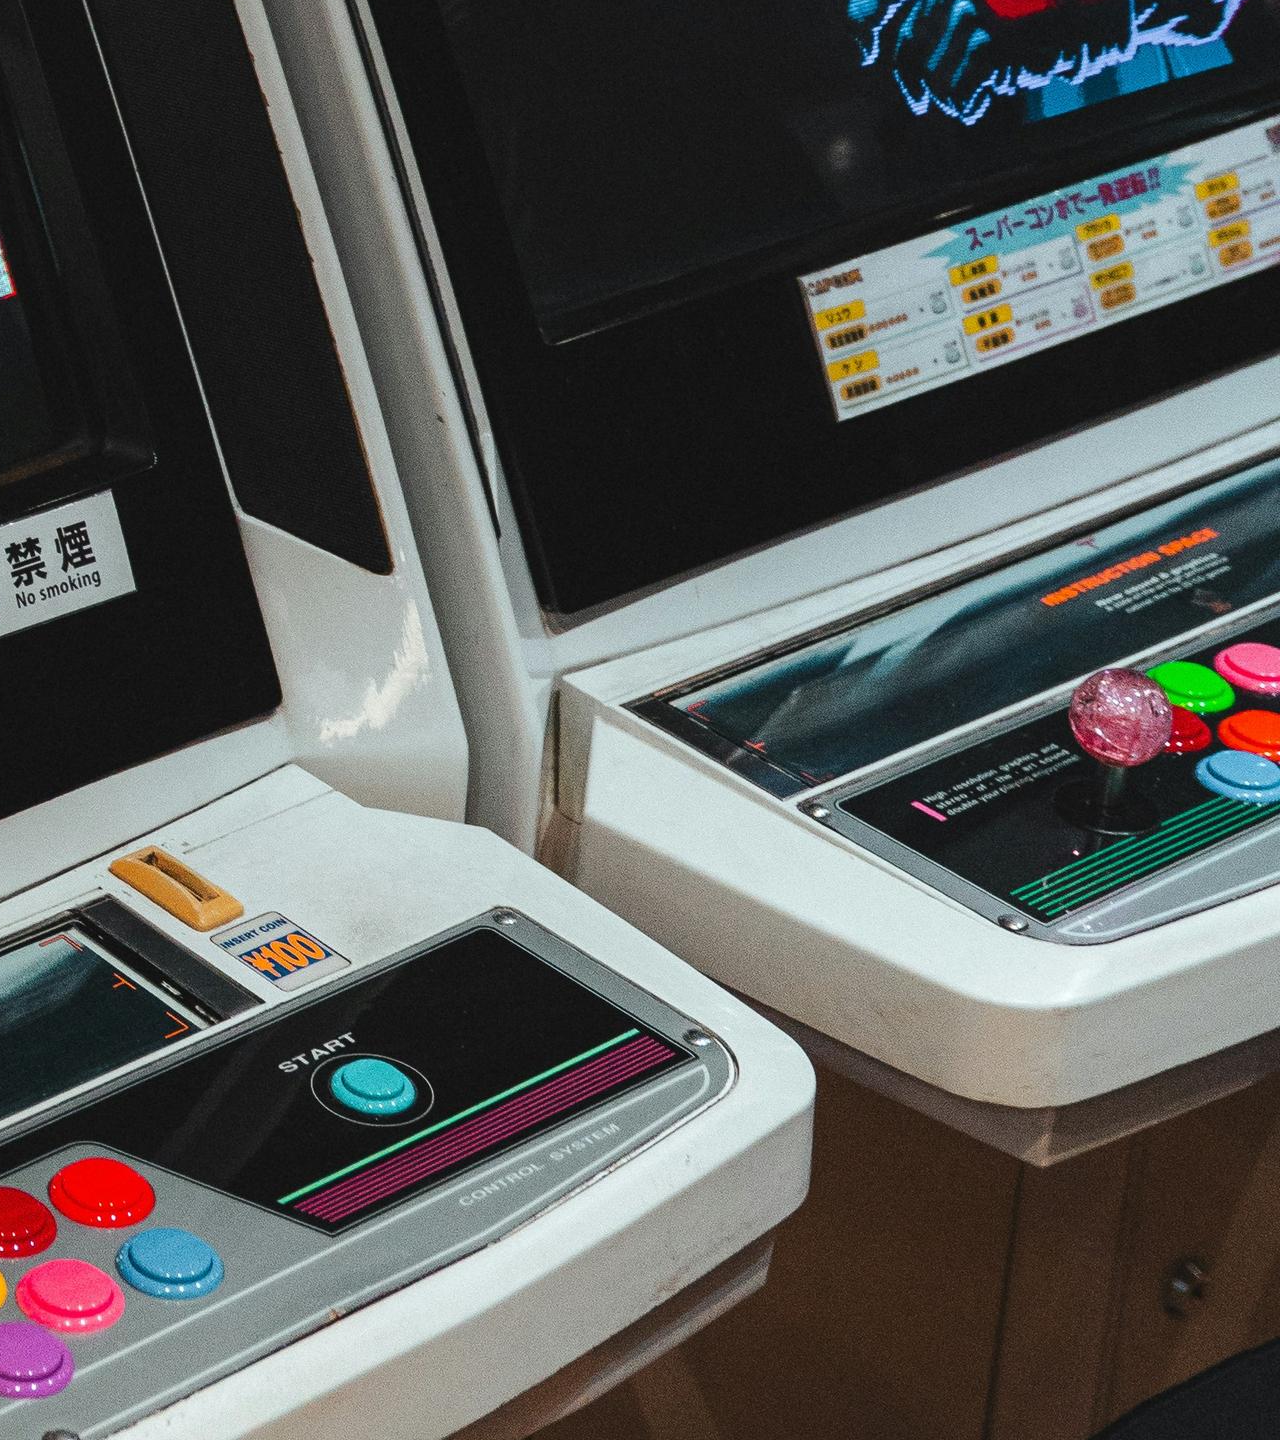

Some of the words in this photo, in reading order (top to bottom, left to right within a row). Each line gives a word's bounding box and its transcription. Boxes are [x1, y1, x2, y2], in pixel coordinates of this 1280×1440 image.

[4, 521, 98, 590] 禁煙
[15, 589, 38, 610] No
[39, 567, 102, 604] smoking
[220, 928, 260, 950] INSERT
[259, 918, 289, 935] COIN
[241, 931, 327, 978] ¥100
[278, 1031, 357, 1074] START
[458, 1162, 543, 1208] CONTROL
[549, 1122, 621, 1163] SYSTEM
